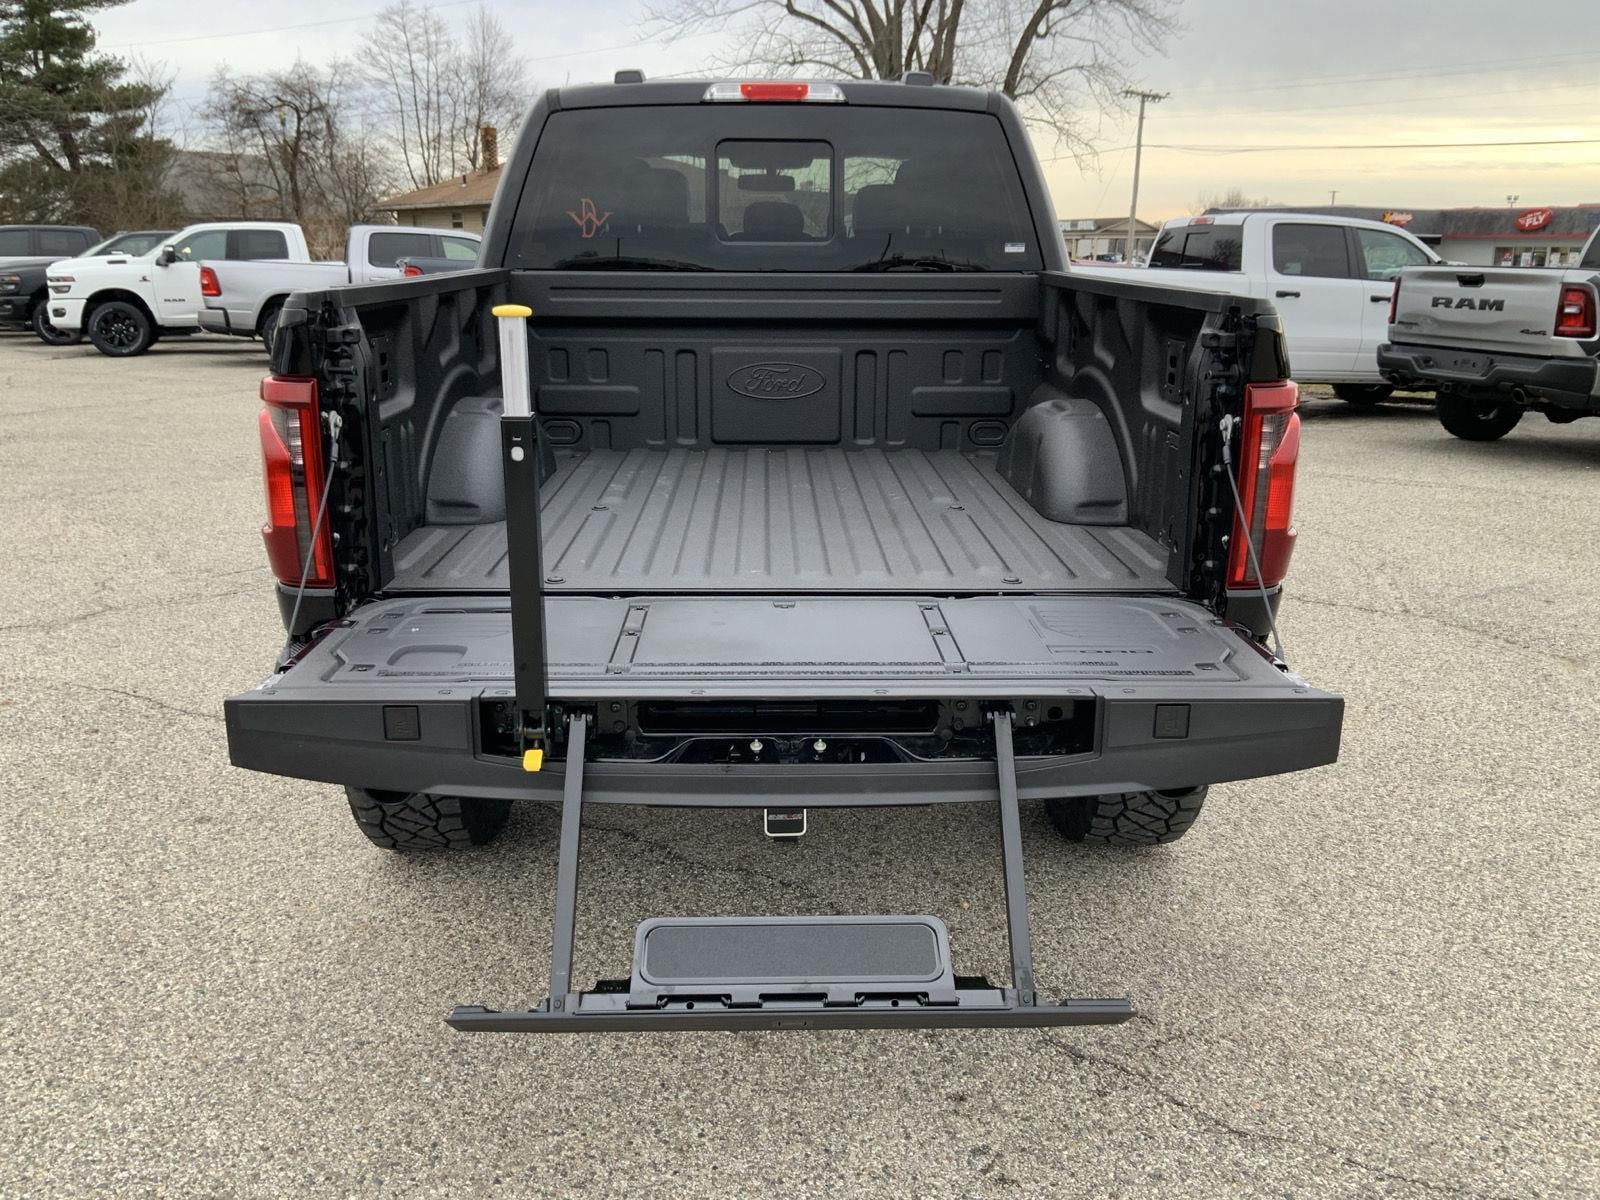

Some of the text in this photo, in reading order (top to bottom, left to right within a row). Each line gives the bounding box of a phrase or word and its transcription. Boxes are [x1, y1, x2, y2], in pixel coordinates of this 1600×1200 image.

[1525, 213, 1547, 228] FLY
[1431, 296, 1506, 312] RAM
[744, 366, 808, 392] Ford
